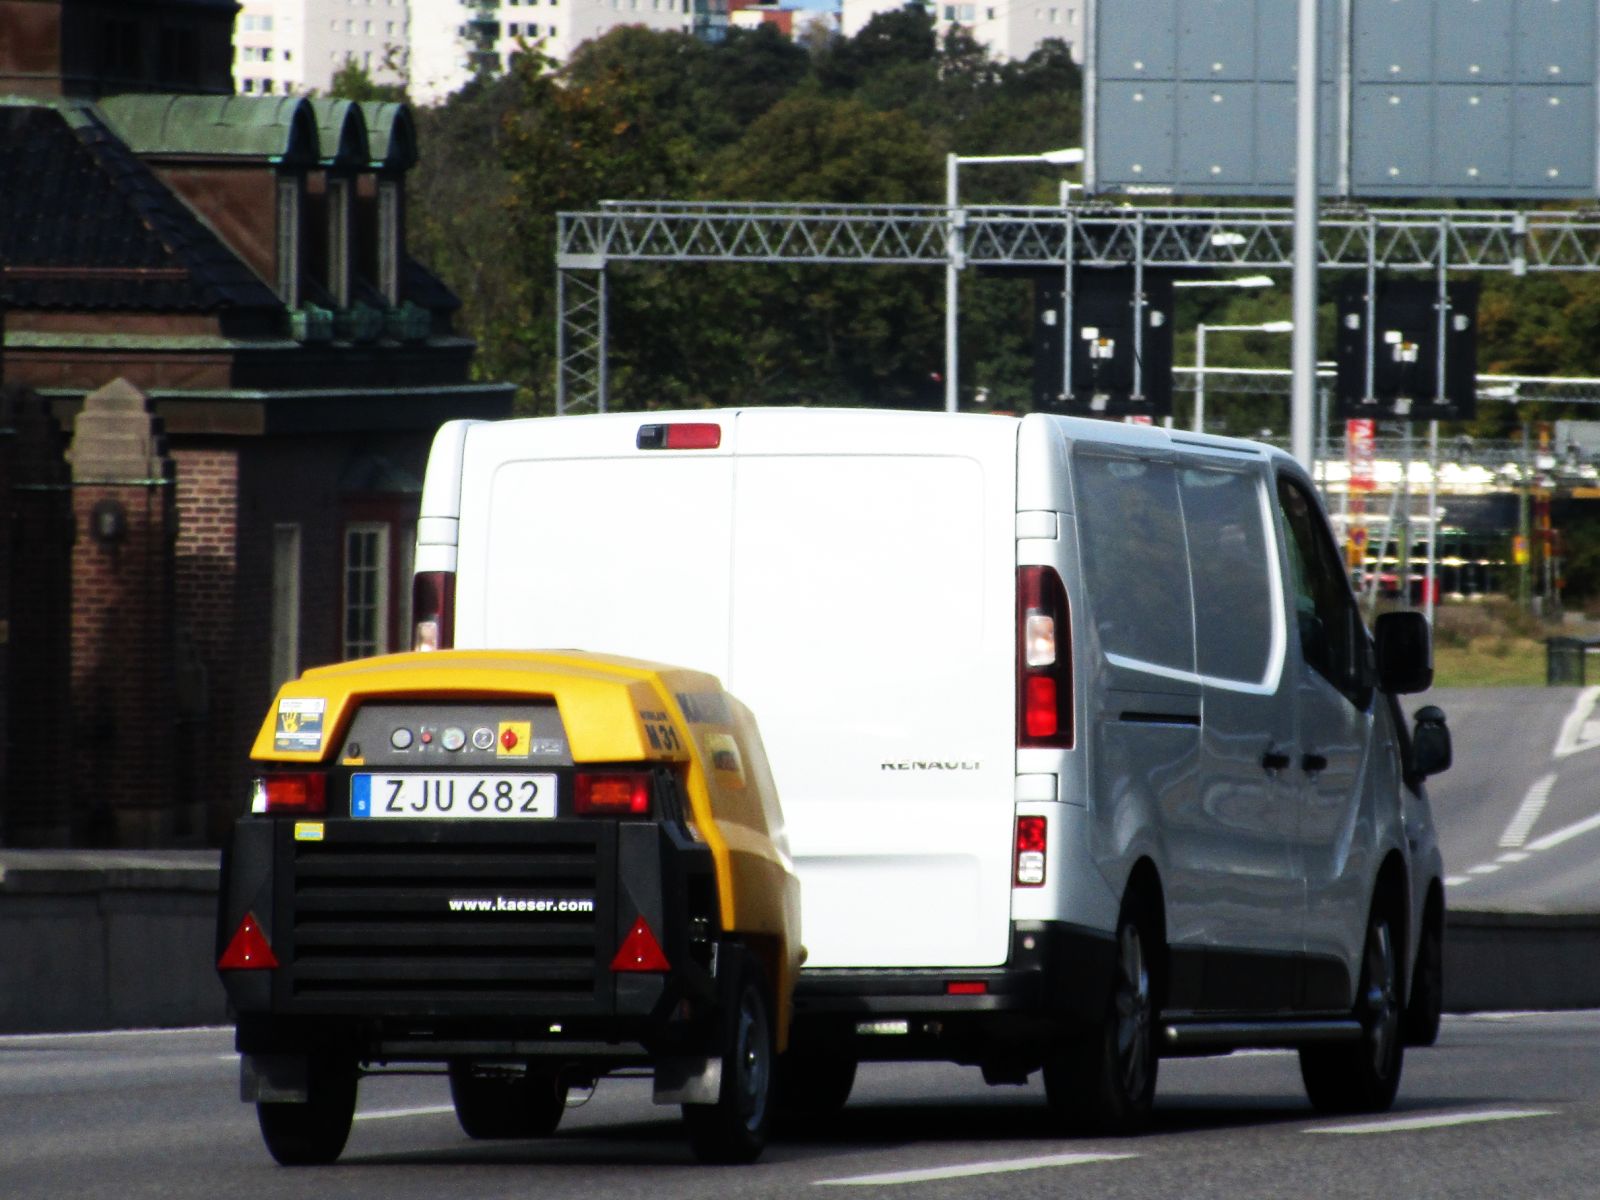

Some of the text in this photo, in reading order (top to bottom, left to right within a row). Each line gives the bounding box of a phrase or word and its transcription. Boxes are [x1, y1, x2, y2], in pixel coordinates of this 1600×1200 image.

[658, 724, 680, 751] 31
[357, 800, 366, 811] S
[385, 779, 539, 812] ZJU 682
[448, 897, 594, 911] www.kaeser.com
